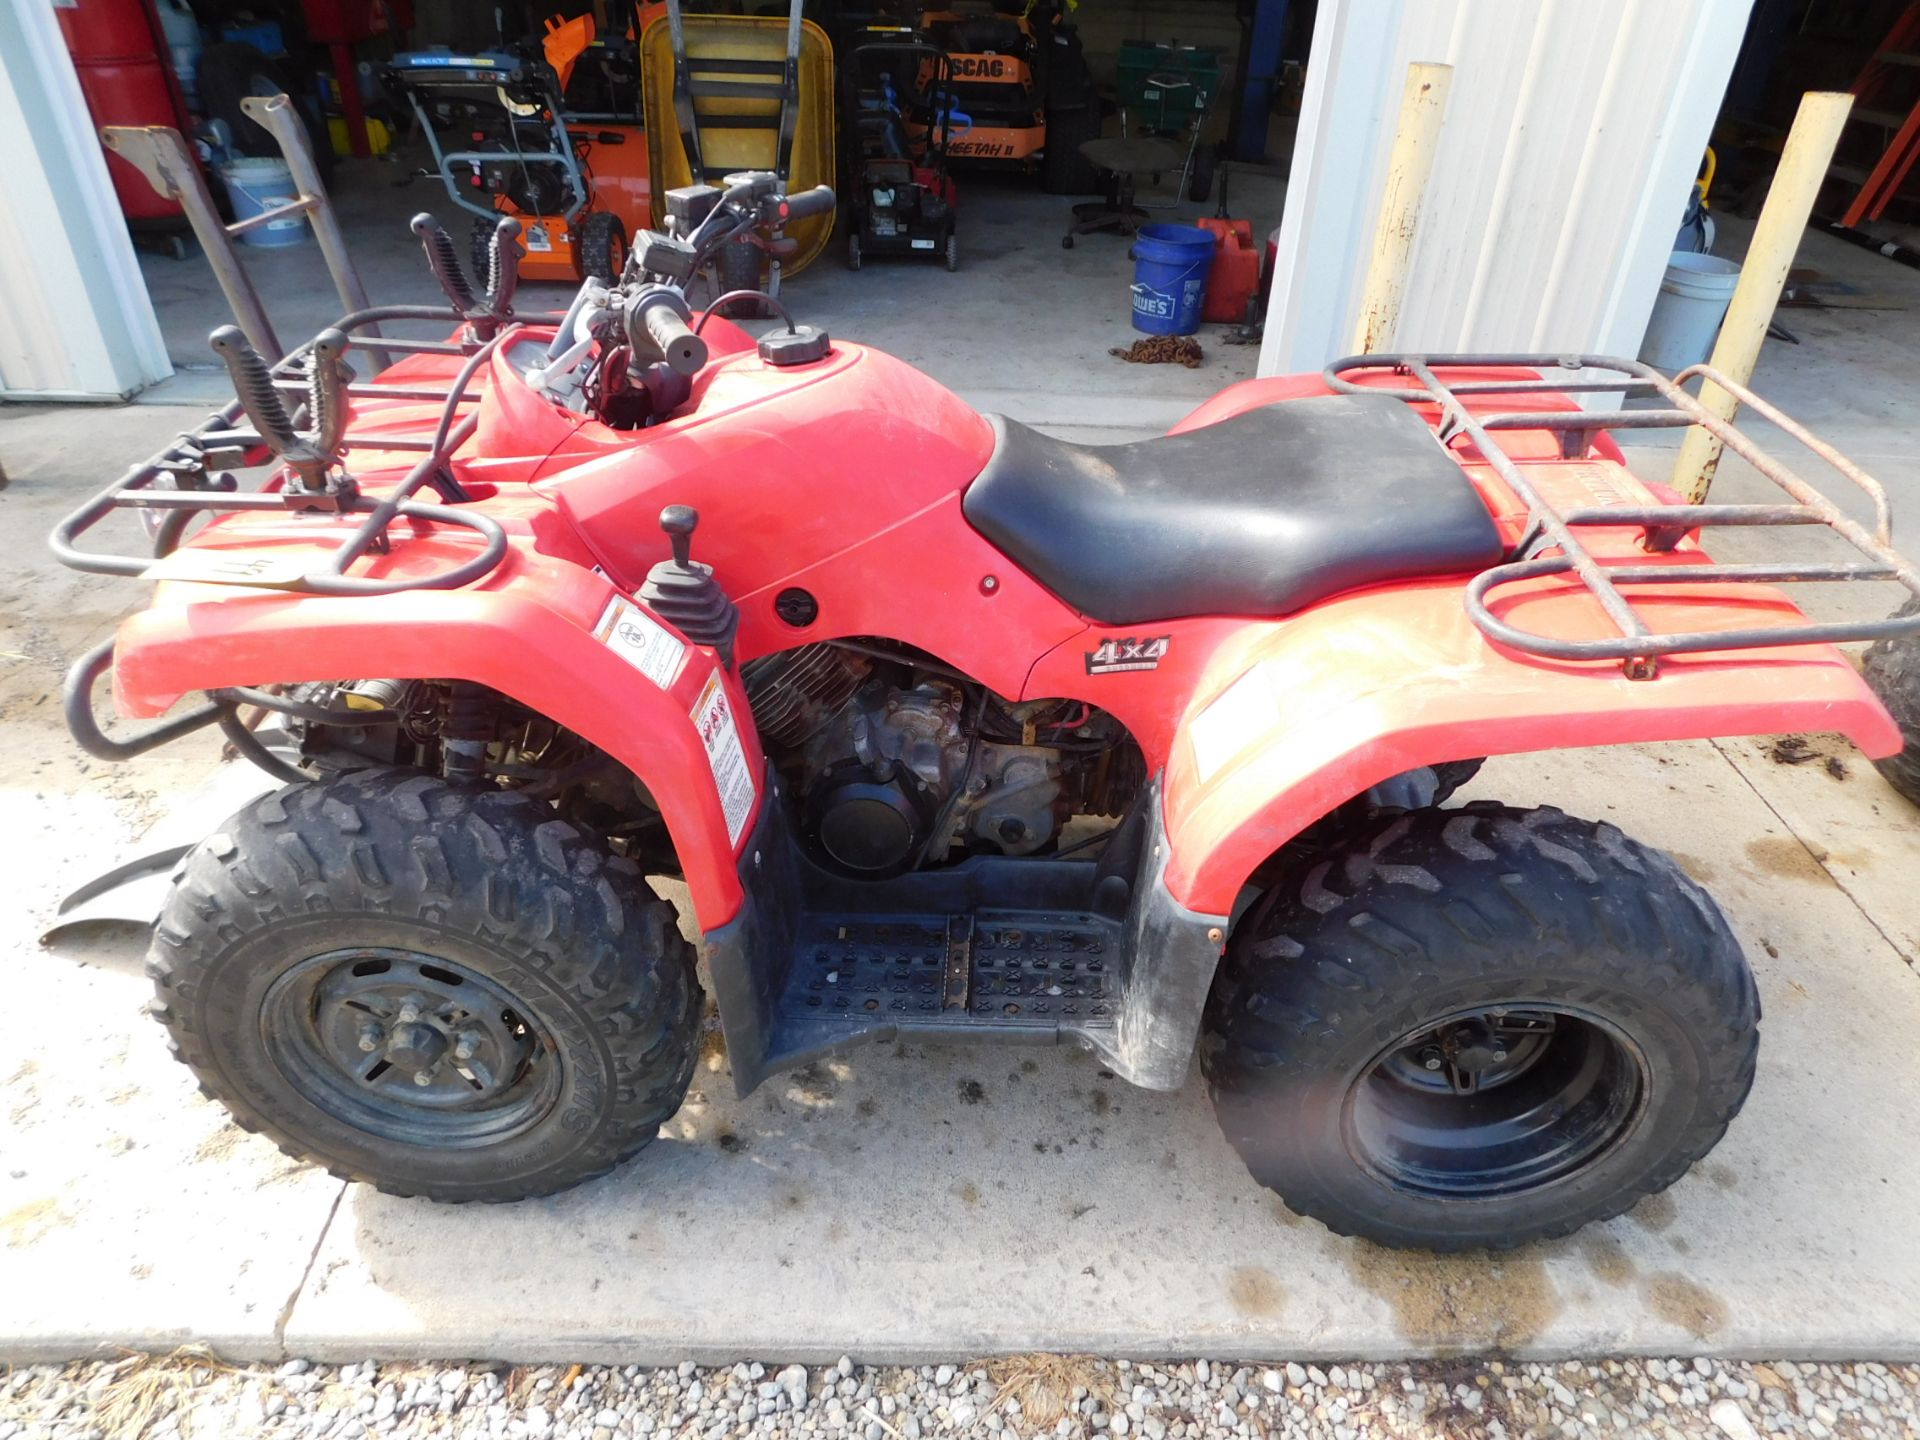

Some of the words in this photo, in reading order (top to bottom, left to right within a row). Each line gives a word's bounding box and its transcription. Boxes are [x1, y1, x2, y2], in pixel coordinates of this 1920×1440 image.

[950, 58, 1004, 77] SCAG
[937, 142, 1003, 156] HEETAH
[1133, 293, 1168, 316] OWE'S
